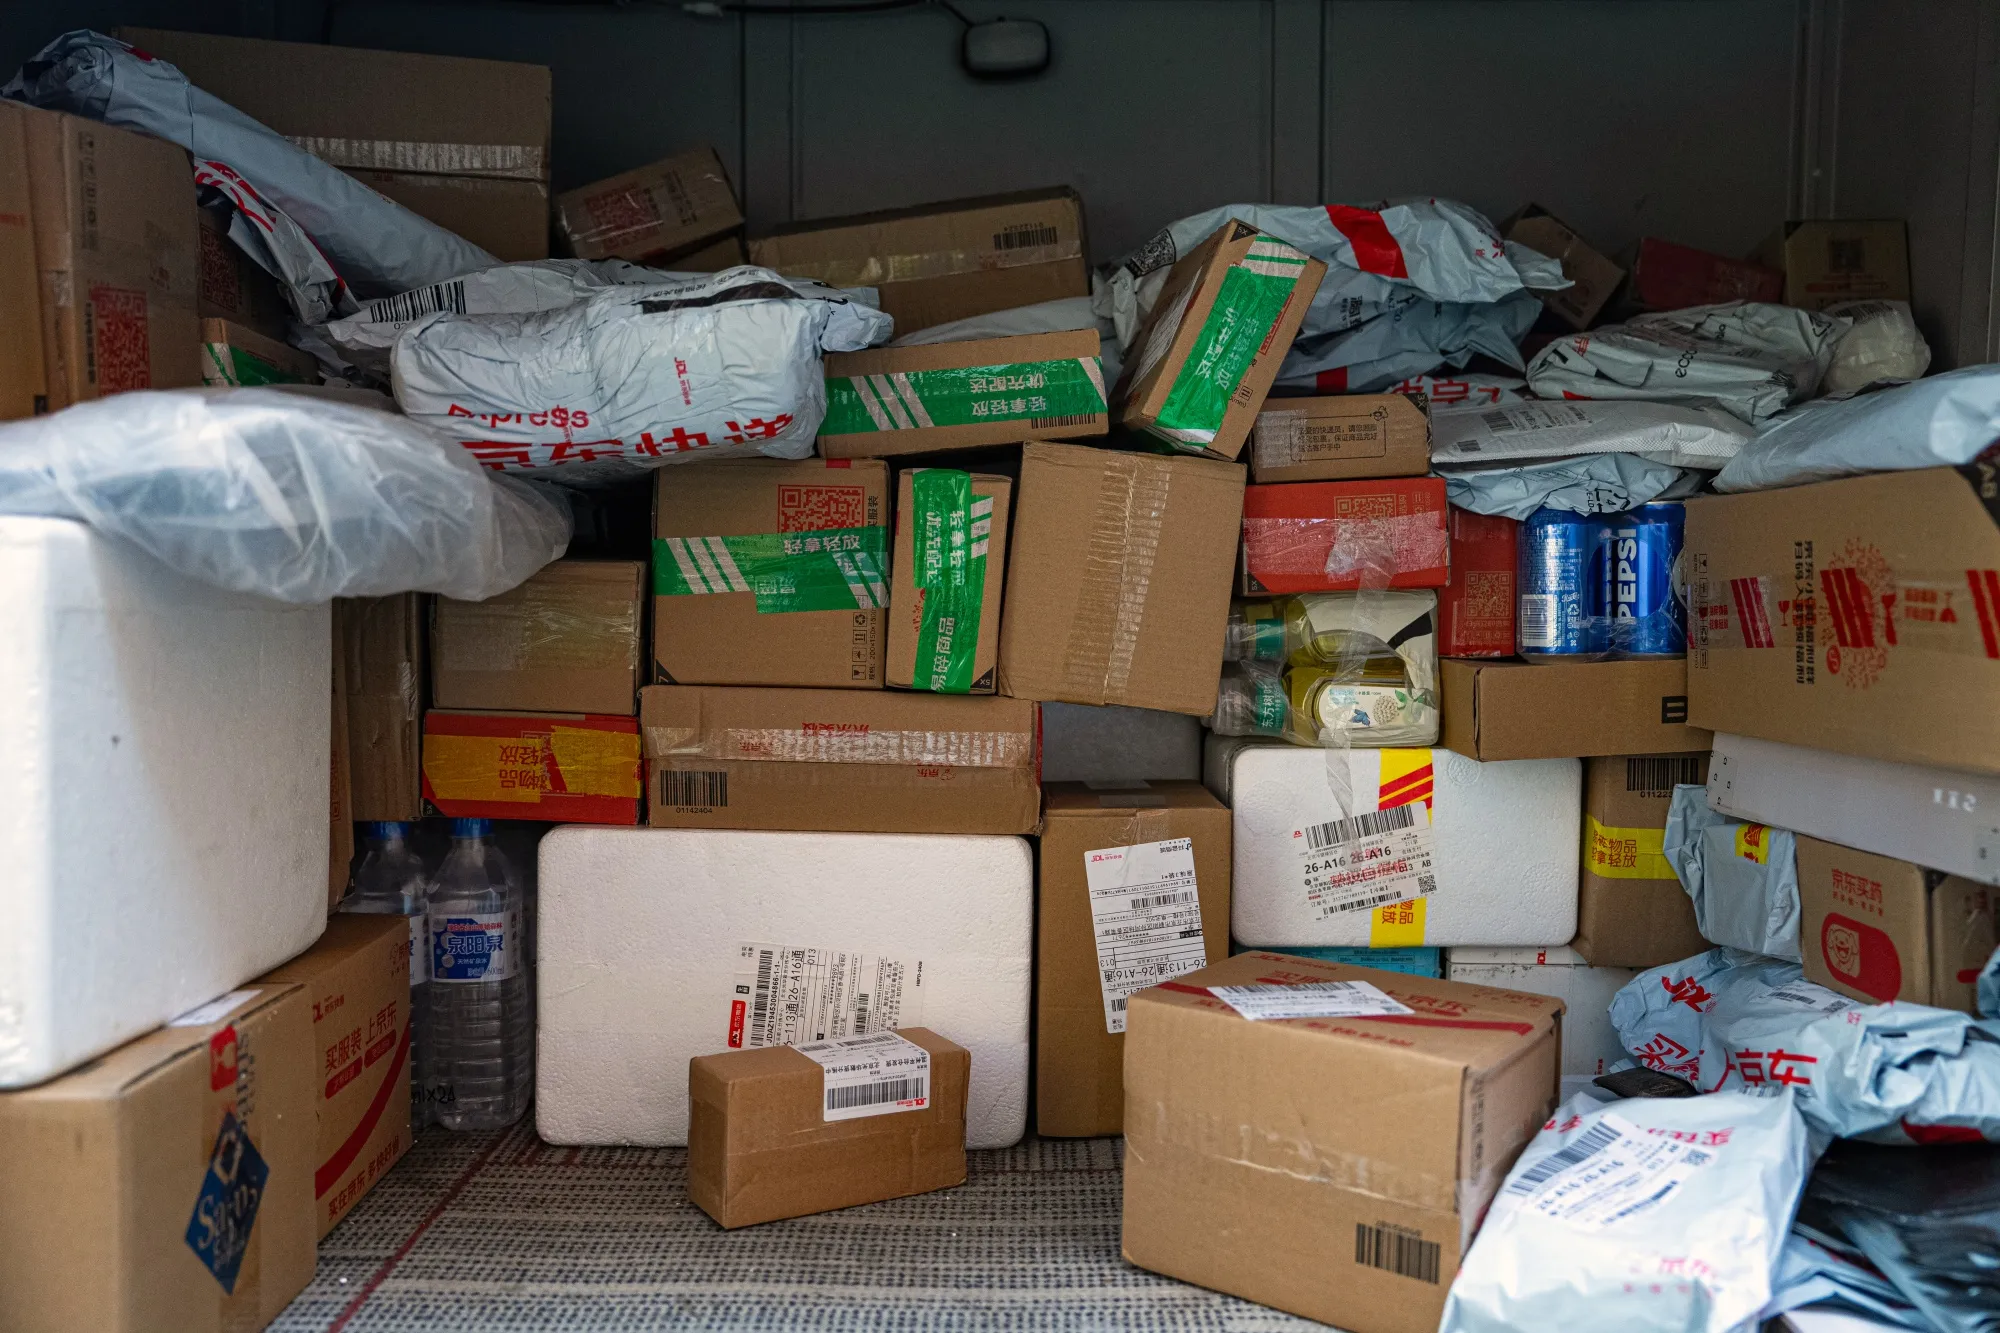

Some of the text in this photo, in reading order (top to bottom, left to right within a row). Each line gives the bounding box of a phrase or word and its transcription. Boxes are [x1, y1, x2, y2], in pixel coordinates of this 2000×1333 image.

[969, 373, 1043, 393] 优先配送
[971, 396, 1046, 416] 轻拿轻放
[784, 535, 861, 555] 轻拿轻放
[1617, 529, 1637, 623] PEPSI
[931, 618, 955, 691] 易碎商品
[1304, 856, 1346, 875] 26-A16
[447, 935, 504, 955] 泉阳泉
[807, 949, 816, 964] 013
[788, 950, 804, 1000] 26-A16通
[325, 1027, 362, 1075] 买服装
[366, 1000, 397, 1045] 上京东
[328, 1170, 365, 1222] 买在京东
